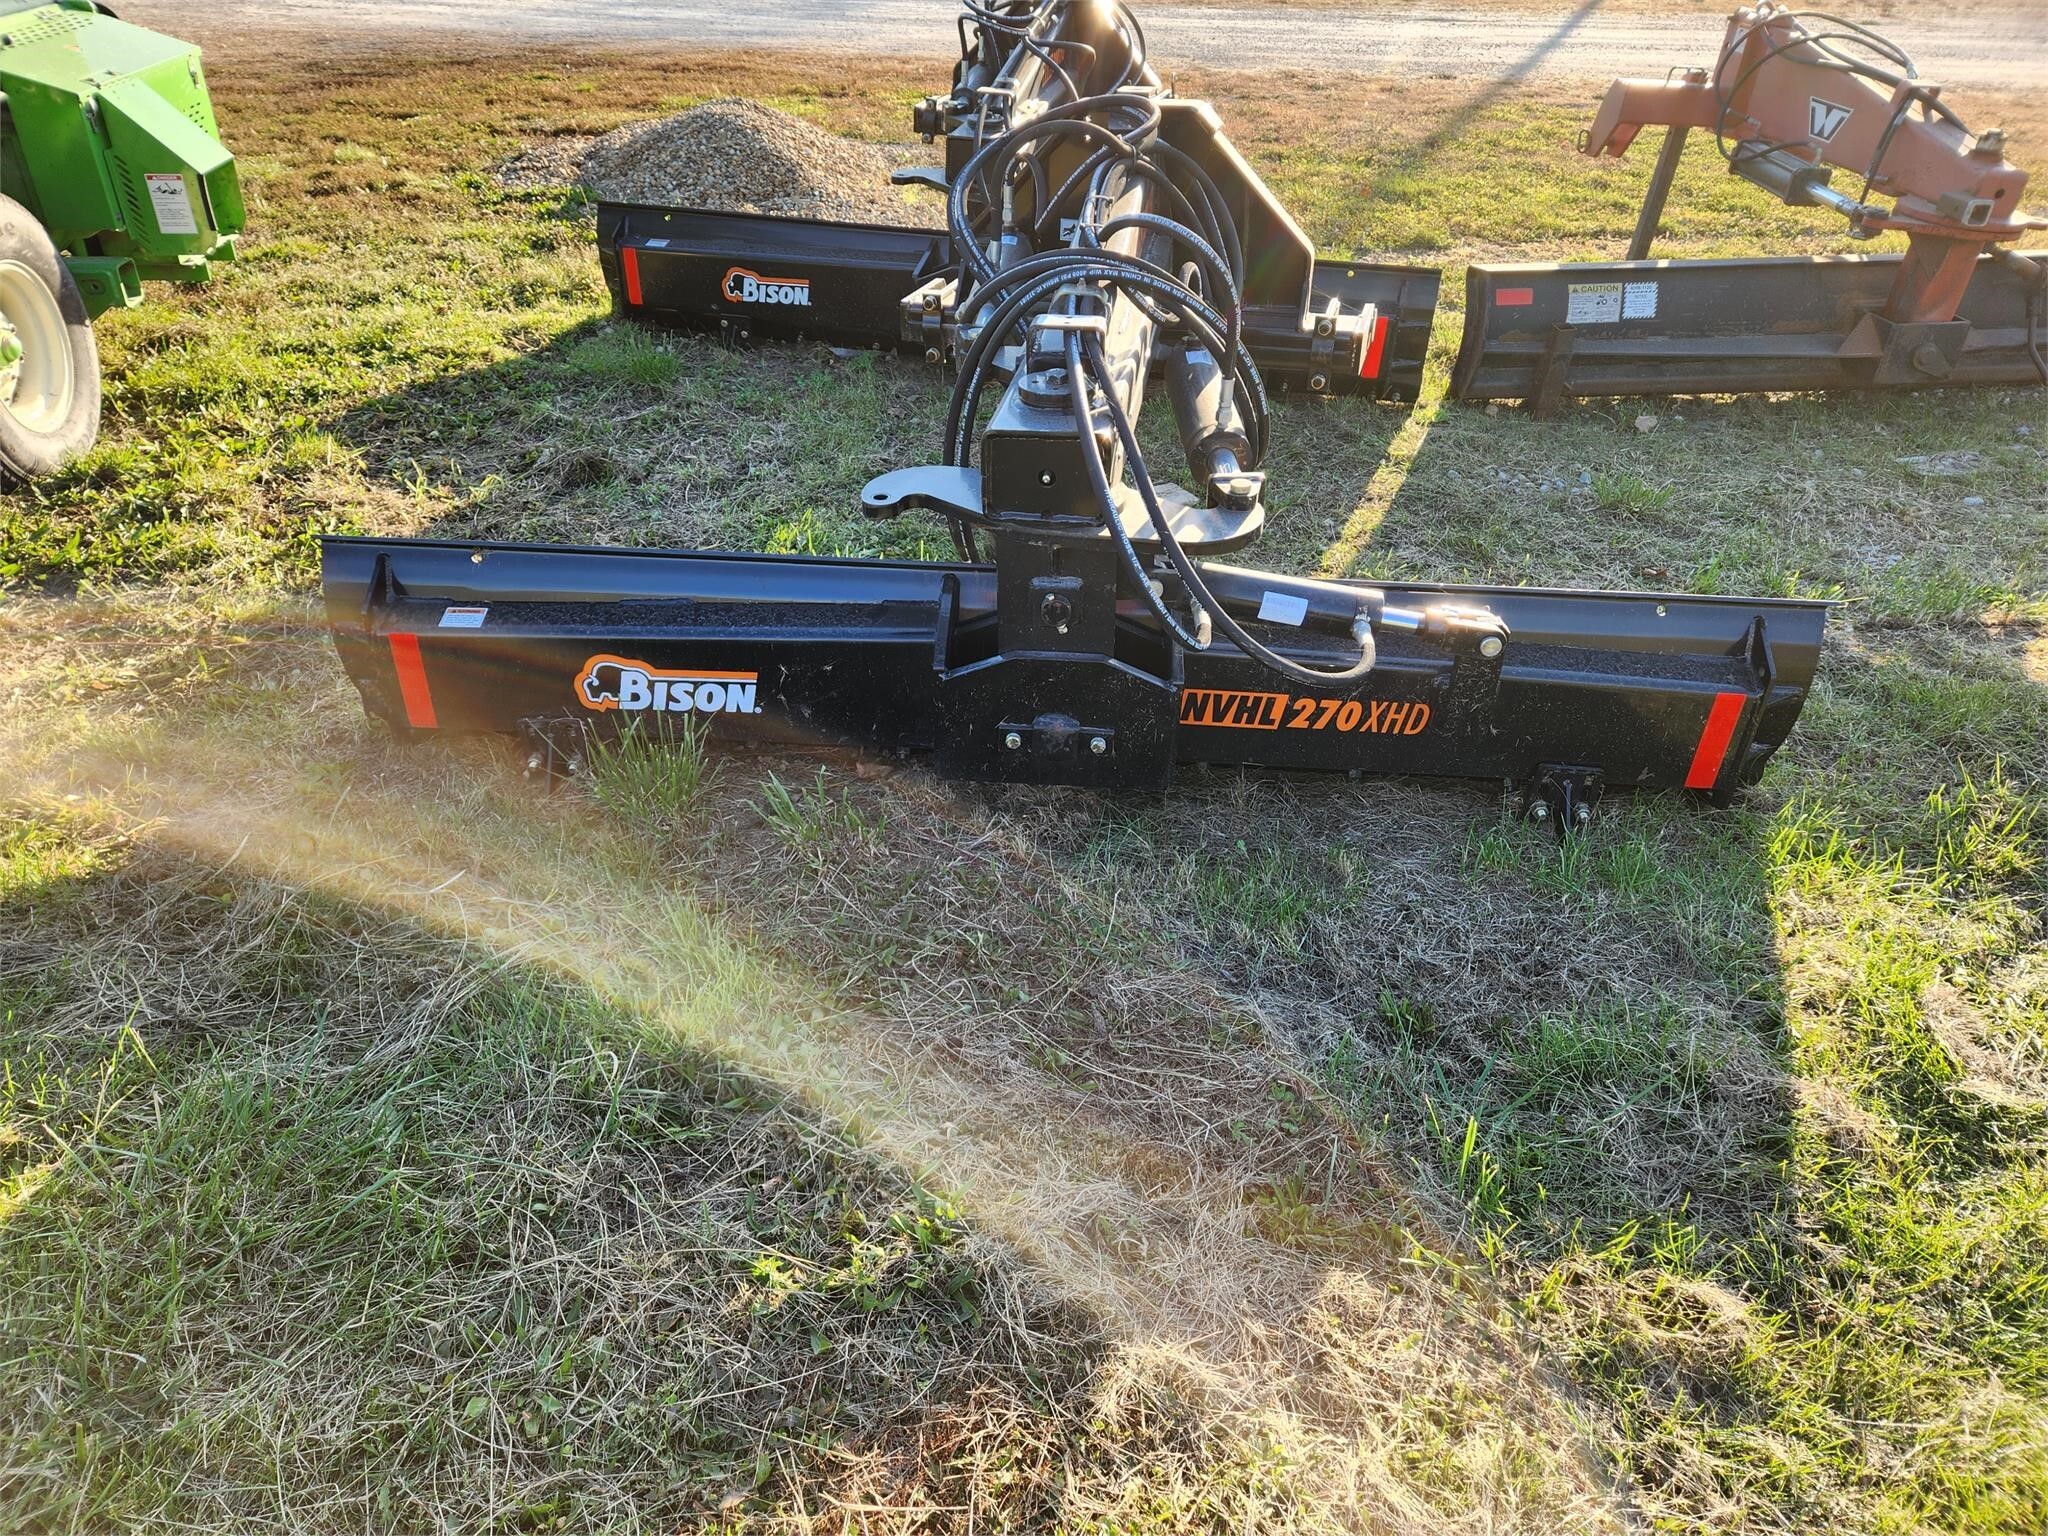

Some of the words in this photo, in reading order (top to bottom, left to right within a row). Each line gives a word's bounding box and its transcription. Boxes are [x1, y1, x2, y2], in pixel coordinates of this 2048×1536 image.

[1102, 268, 1118, 276] MAX
[1120, 270, 1142, 280] CHINA
[1142, 275, 1150, 284] IN
[1151, 279, 1171, 291] MADE
[743, 277, 809, 306] BISON
[1581, 285, 1619, 293] CAUTION
[1103, 489, 1124, 531] HYDRAULIC
[1121, 533, 1133, 554] HOSE
[1137, 571, 1150, 588] SAE
[619, 671, 757, 714] BISON
[1180, 692, 1281, 726] NVHL
